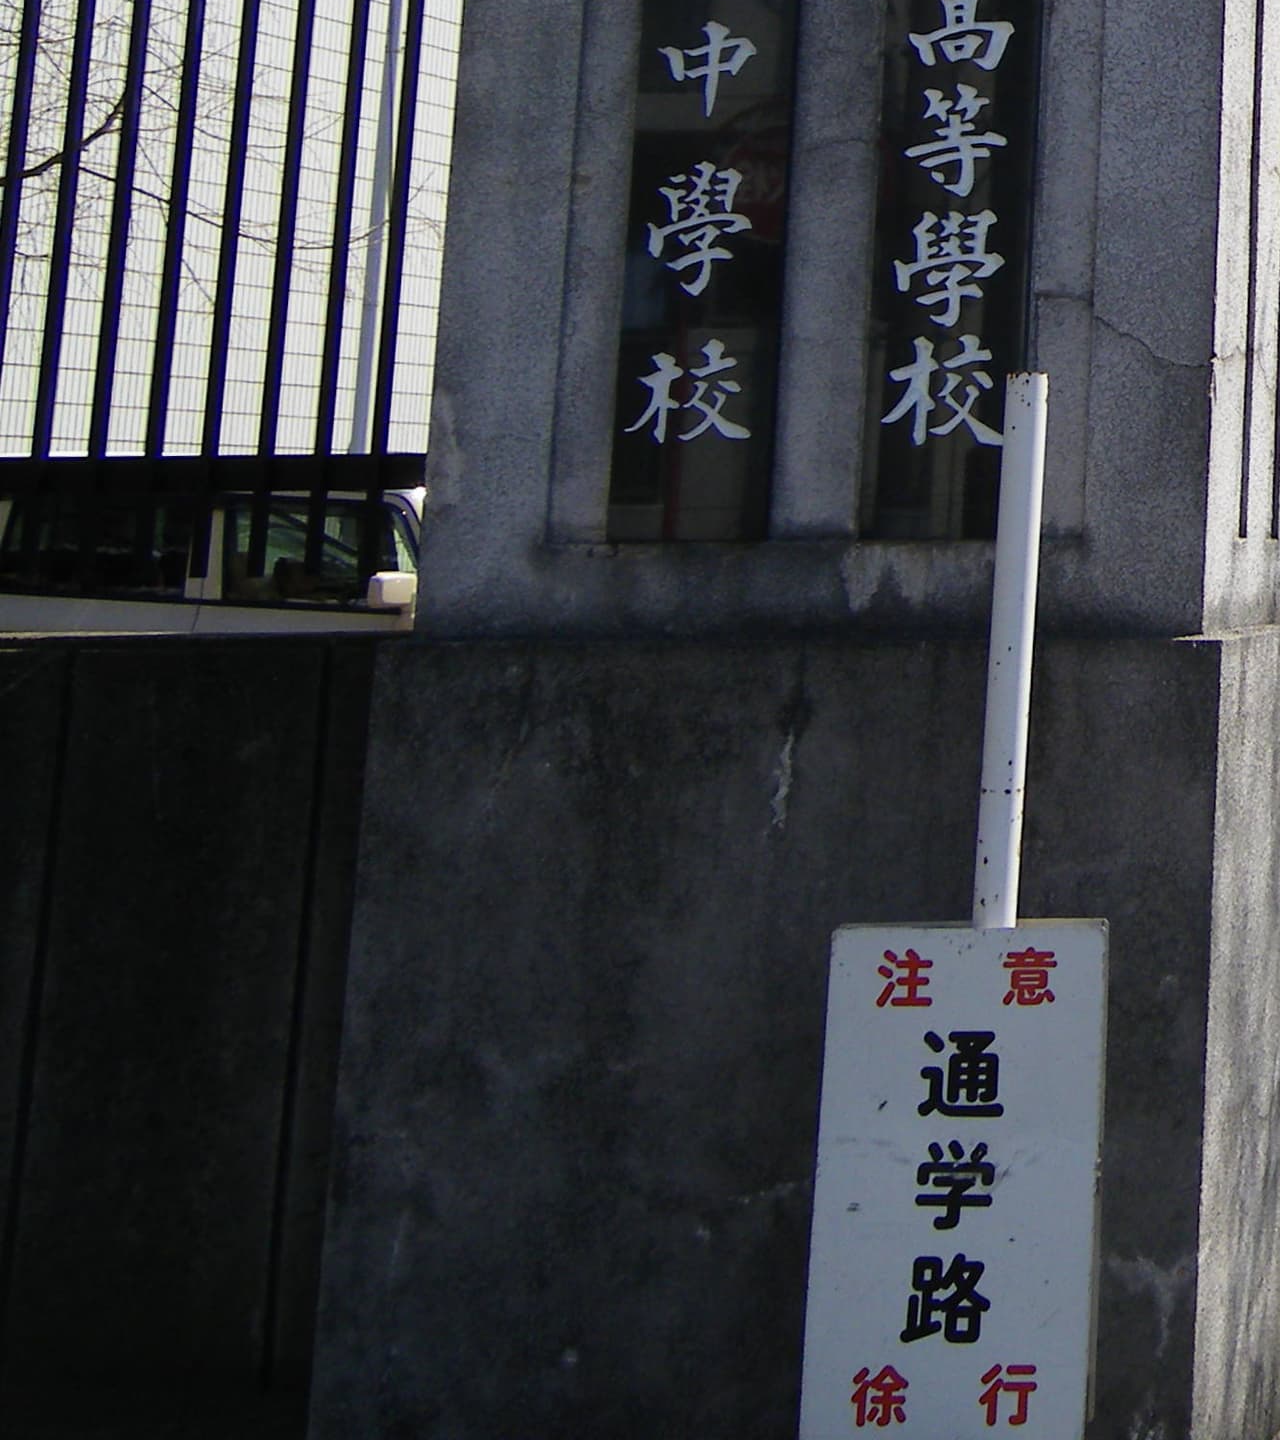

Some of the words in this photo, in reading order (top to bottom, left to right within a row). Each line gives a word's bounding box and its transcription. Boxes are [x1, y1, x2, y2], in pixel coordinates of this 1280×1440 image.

[876, 947, 1057, 1007] 注意
[900, 1030, 1004, 1344] 通学路
[850, 1363, 1038, 1427] 徐行
